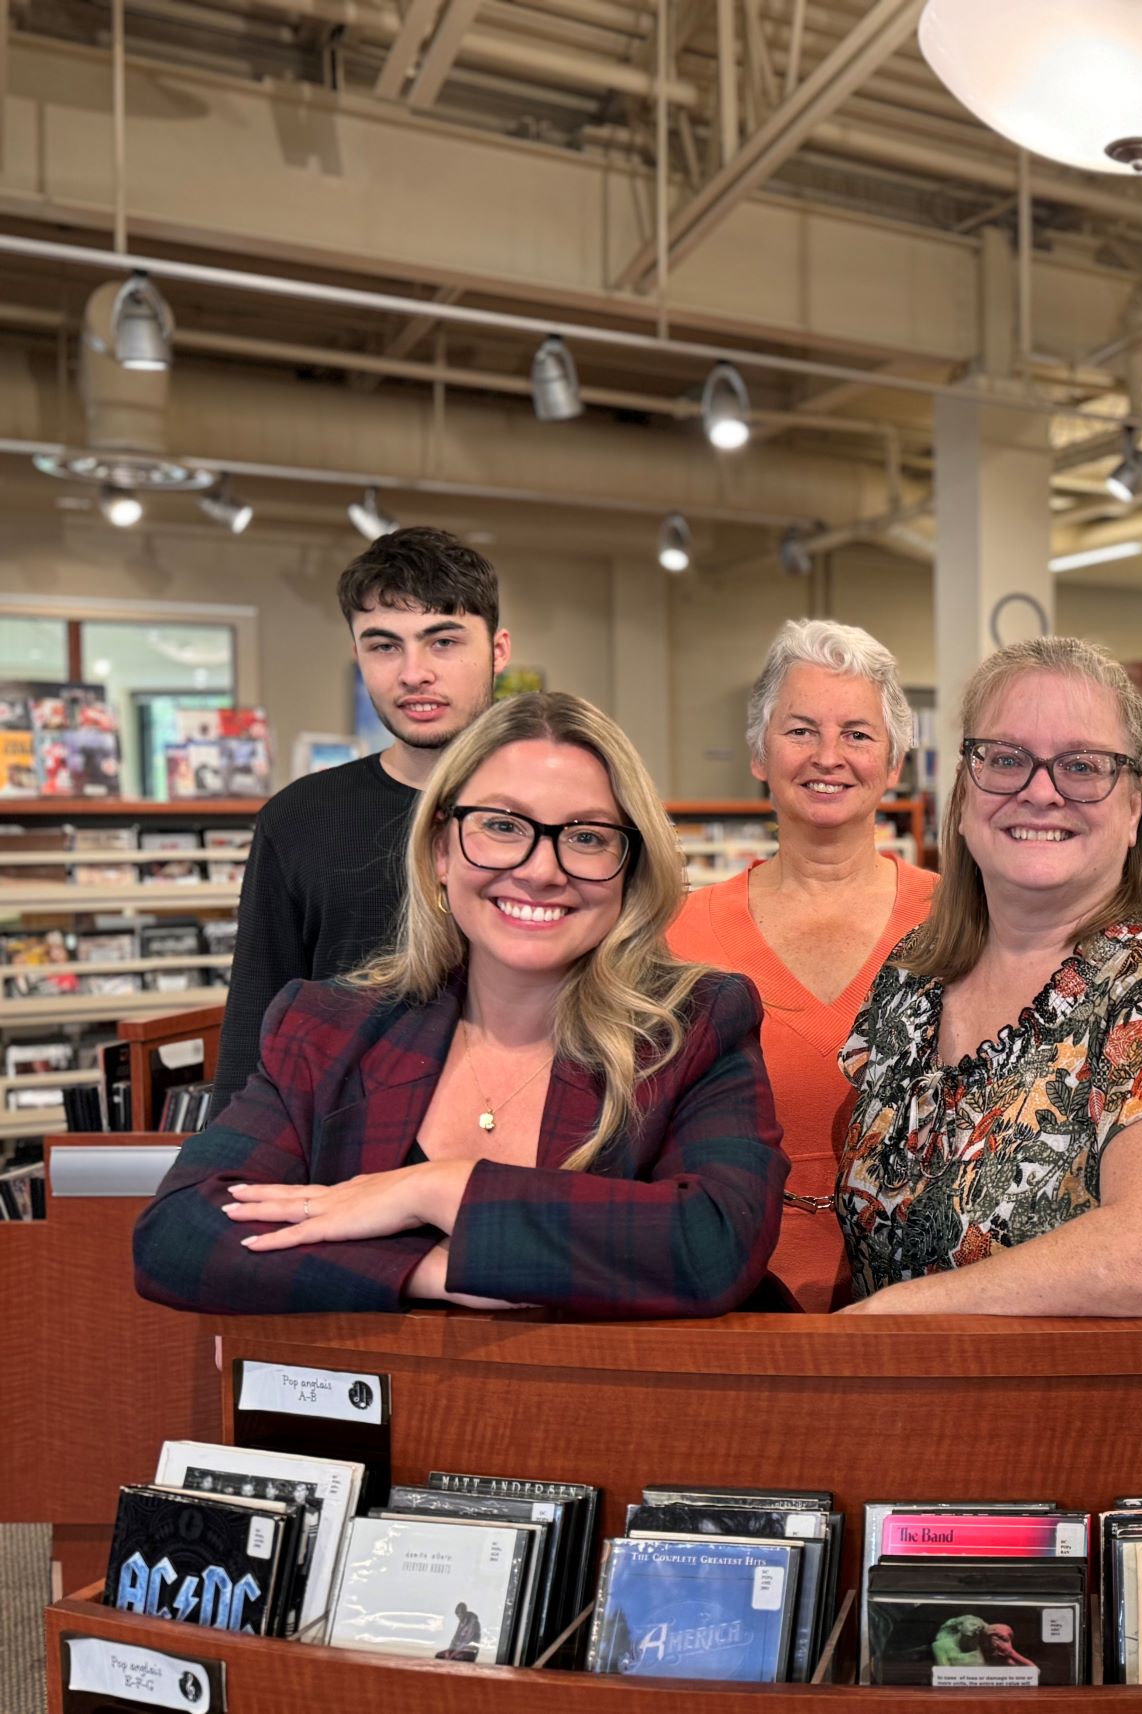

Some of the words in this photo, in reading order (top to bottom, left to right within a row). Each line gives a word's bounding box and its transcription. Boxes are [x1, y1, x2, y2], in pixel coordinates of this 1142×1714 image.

[282, 1374, 298, 1388] Pop
[301, 1378, 332, 1393] anglais
[298, 1390, 317, 1402] A-B
[442, 1475, 481, 1490] MATT
[898, 1527, 918, 1543] The
[922, 1528, 954, 1543] Band
[631, 1552, 649, 1562] THE
[652, 1553, 697, 1565] COMPLETE
[700, 1555, 742, 1566] GREATEST
[745, 1557, 767, 1566] HITS
[116, 1551, 261, 1635] AC/DC
